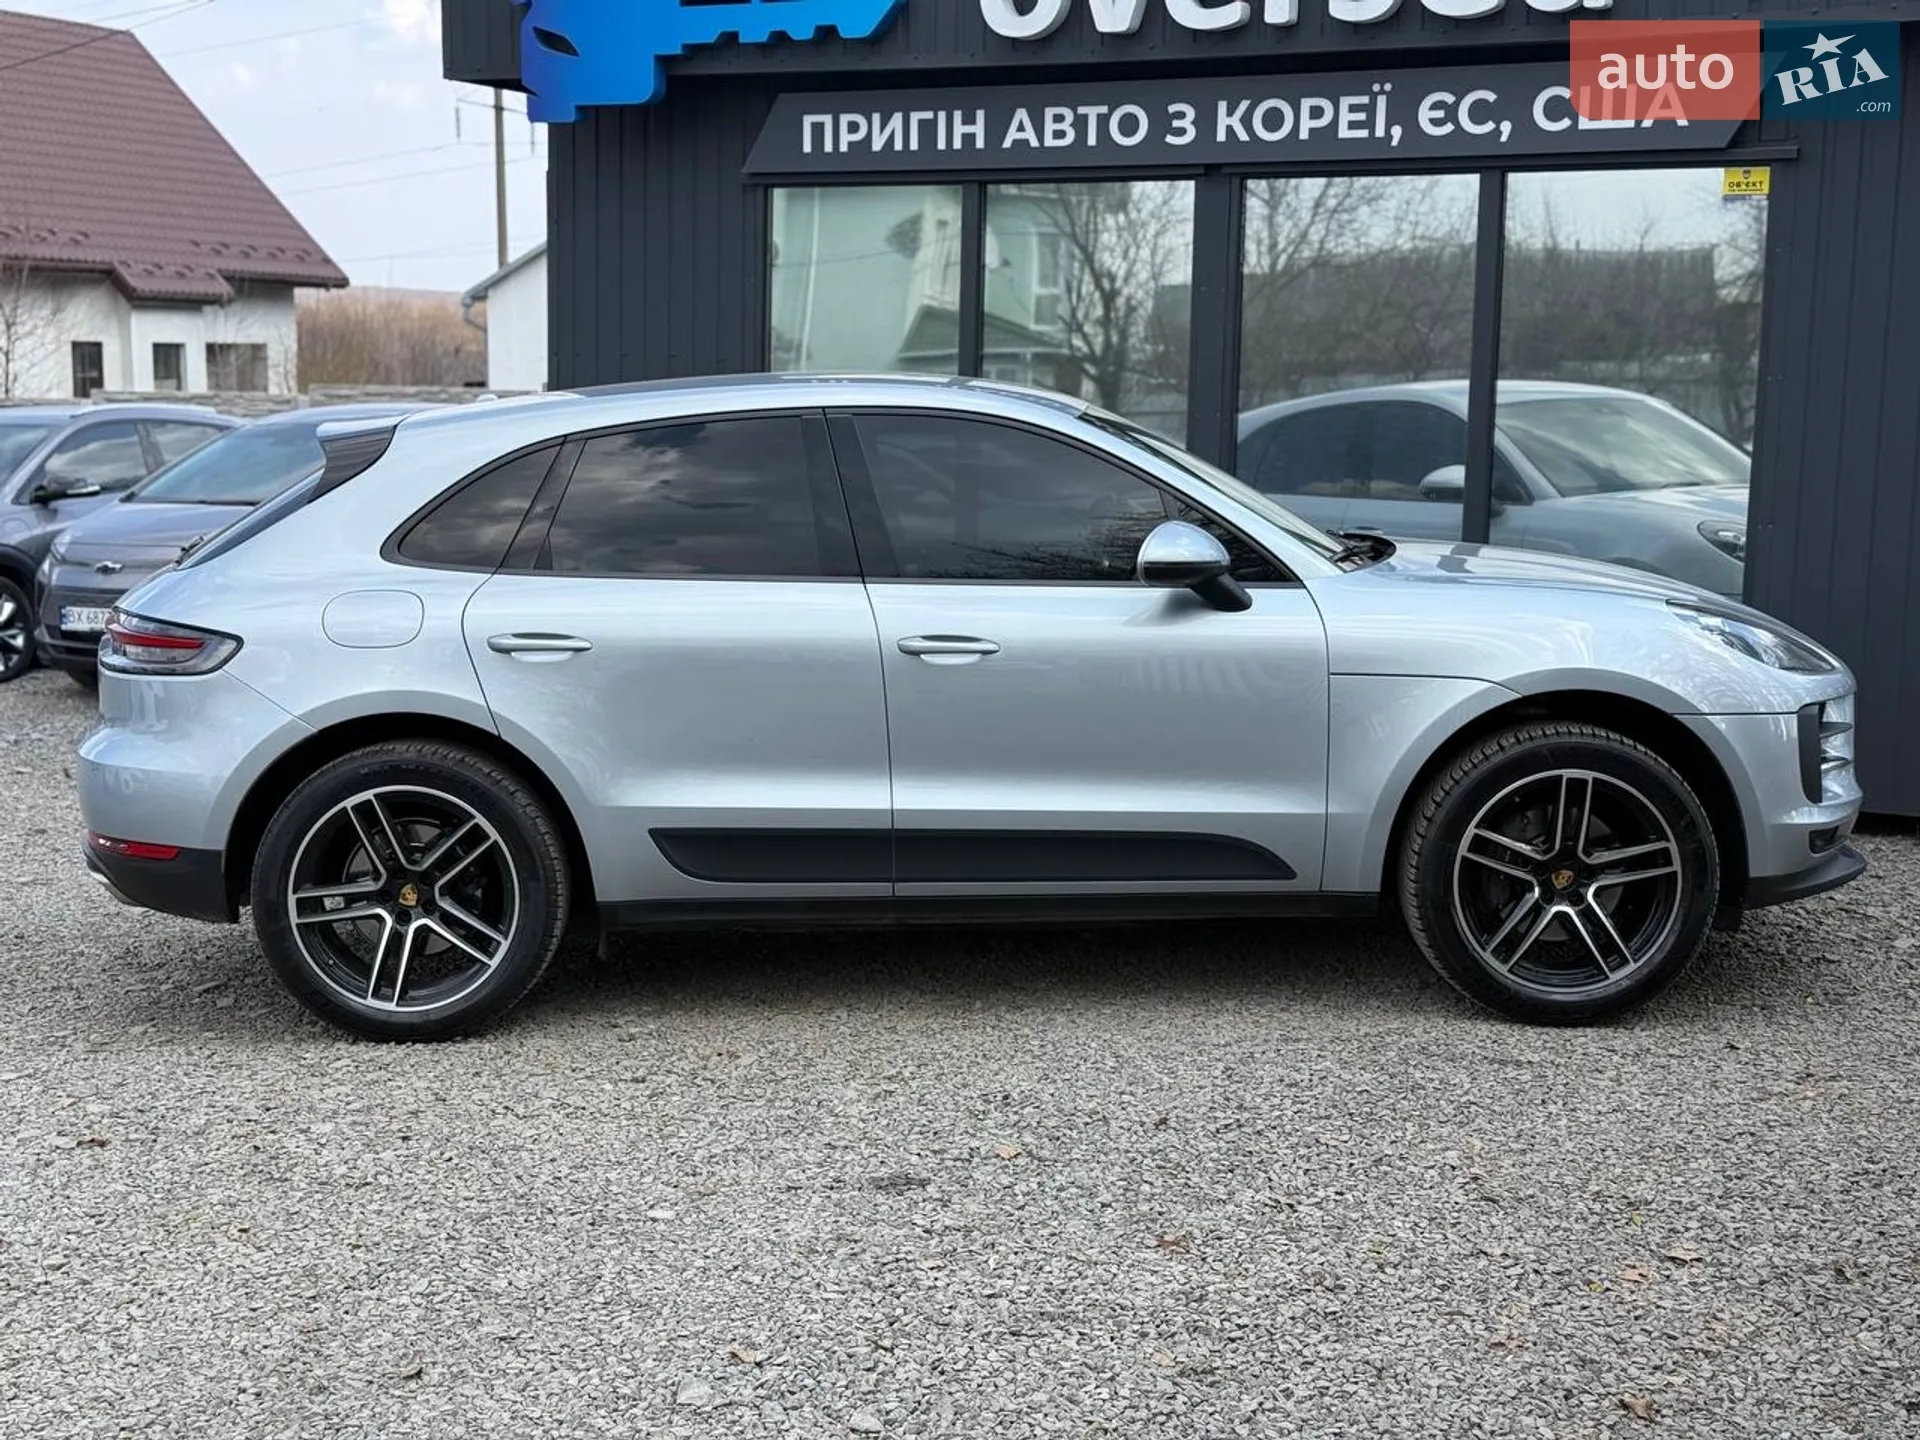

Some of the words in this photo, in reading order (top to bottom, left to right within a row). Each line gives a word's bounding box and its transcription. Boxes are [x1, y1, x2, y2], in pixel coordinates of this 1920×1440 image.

[802, 109, 986, 154] ПРИГІН
[1001, 105, 1150, 149] АВТО
[1216, 82, 1403, 147] КОРЕЇ,
[1417, 89, 1514, 143] ЄС,
[1532, 80, 1689, 132] США
